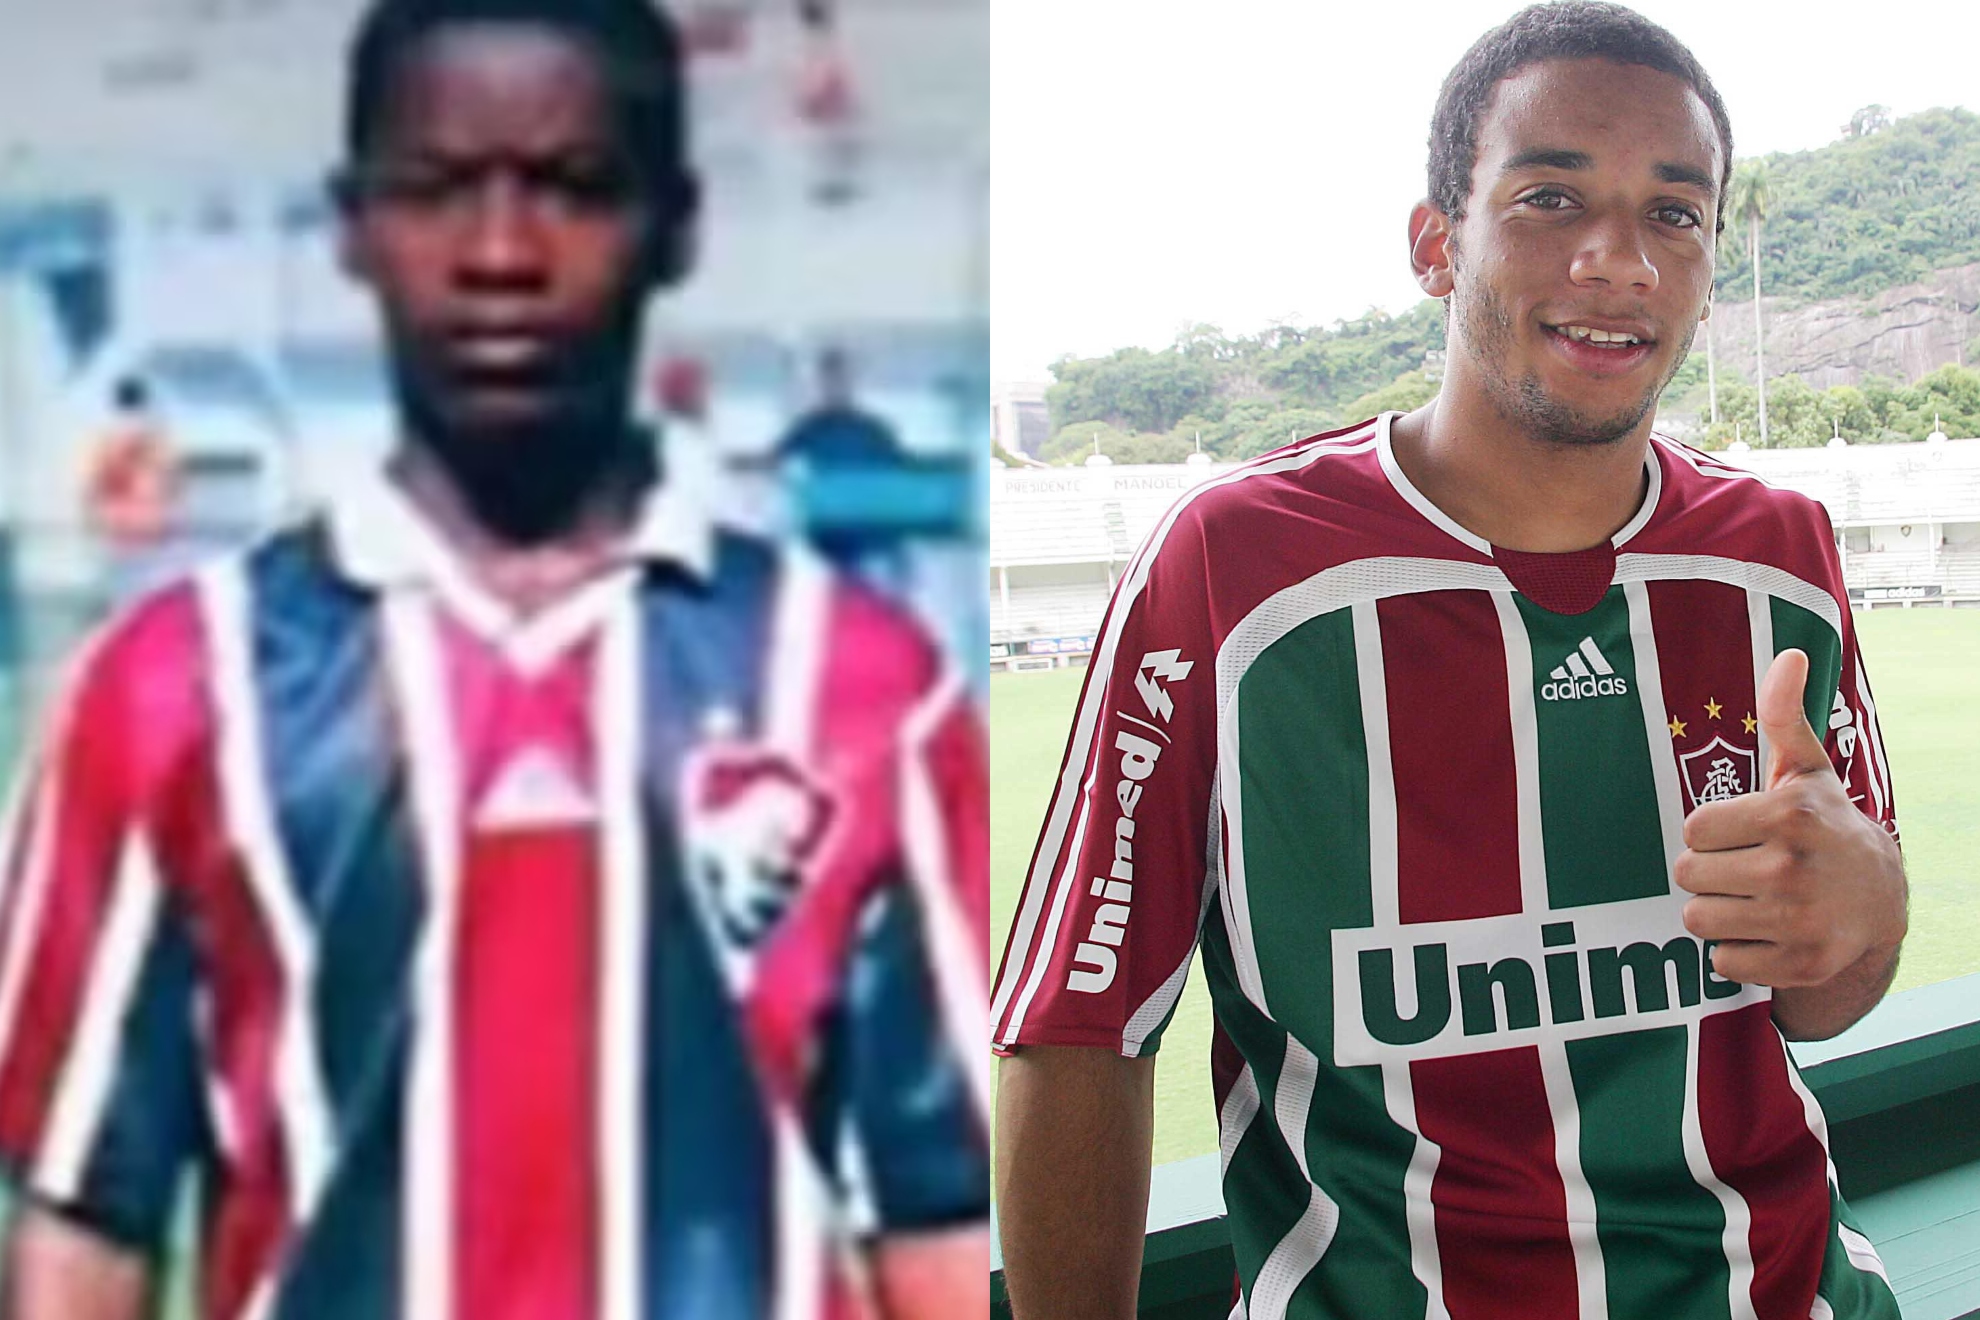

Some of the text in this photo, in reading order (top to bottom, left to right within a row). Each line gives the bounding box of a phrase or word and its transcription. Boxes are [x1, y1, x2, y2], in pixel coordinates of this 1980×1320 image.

[1005, 477, 1187, 493] PRESIDENTE MANOEL
[1541, 674, 1627, 700] adidas
[1067, 731, 1162, 993] Unimed
